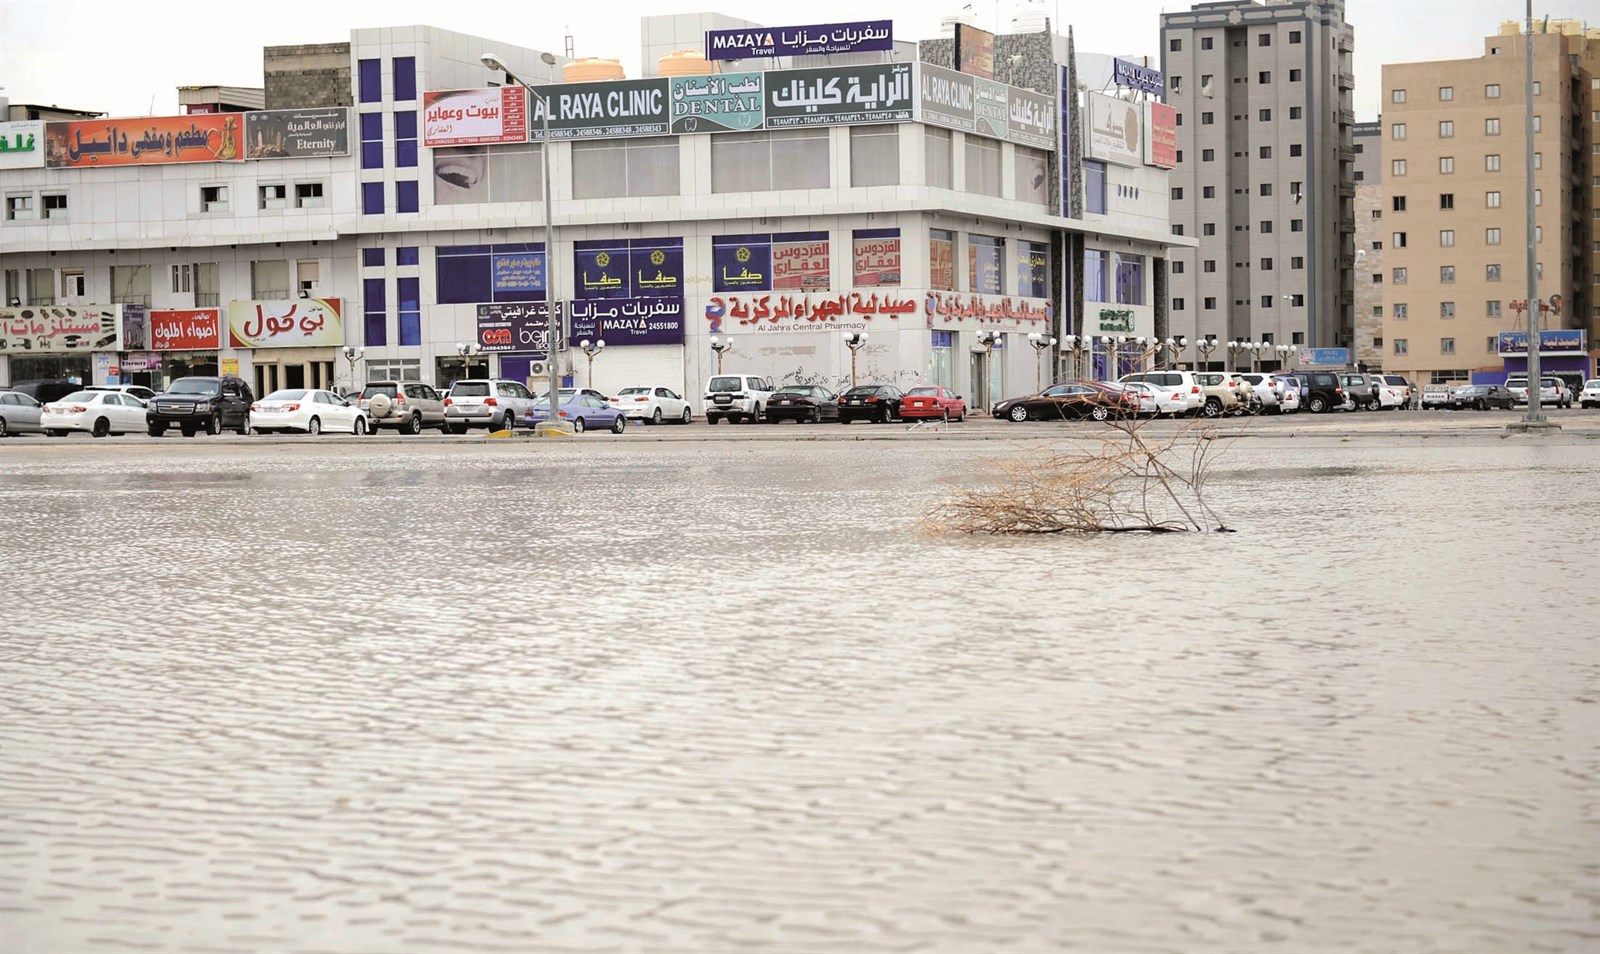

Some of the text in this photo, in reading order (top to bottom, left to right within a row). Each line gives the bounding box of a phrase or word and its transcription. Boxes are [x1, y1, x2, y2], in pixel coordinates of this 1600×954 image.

[713, 33, 775, 49] MAZAYA
[781, 25, 889, 49] سفريات مزايا
[751, 47, 775, 56] Travel
[728, 76, 760, 99] لطب
[772, 73, 910, 112] الراية كلينك
[922, 74, 973, 111] AL RAYA CLINIC
[427, 104, 499, 123] بيوت وعماير
[534, 95, 556, 121] AL
[560, 91, 604, 120] RAYA
[607, 88, 663, 117] CLINIC
[674, 97, 761, 116] DENTAL
[976, 101, 1006, 120] DENTAL
[287, 120, 322, 132] العالمية
[175, 123, 209, 158] مطعم
[296, 138, 336, 151] Eternity
[722, 265, 763, 281] صفا
[774, 257, 830, 277] العقاري
[855, 254, 901, 273] العقاري
[583, 270, 622, 285] صفا
[638, 269, 677, 284] صفا
[571, 299, 680, 321] سفريات مزايا
[728, 291, 916, 325] صيدلية الجهراء المركزية
[10, 318, 100, 338] مستلزمات
[155, 319, 217, 341] أضواء الملوك
[243, 303, 325, 338] بي كول
[603, 319, 647, 330] MAZAYA
[648, 322, 679, 330] 24551800
[768, 324, 791, 332] Jahra
[792, 323, 823, 332] Central
[824, 322, 867, 330] Pharmacy
